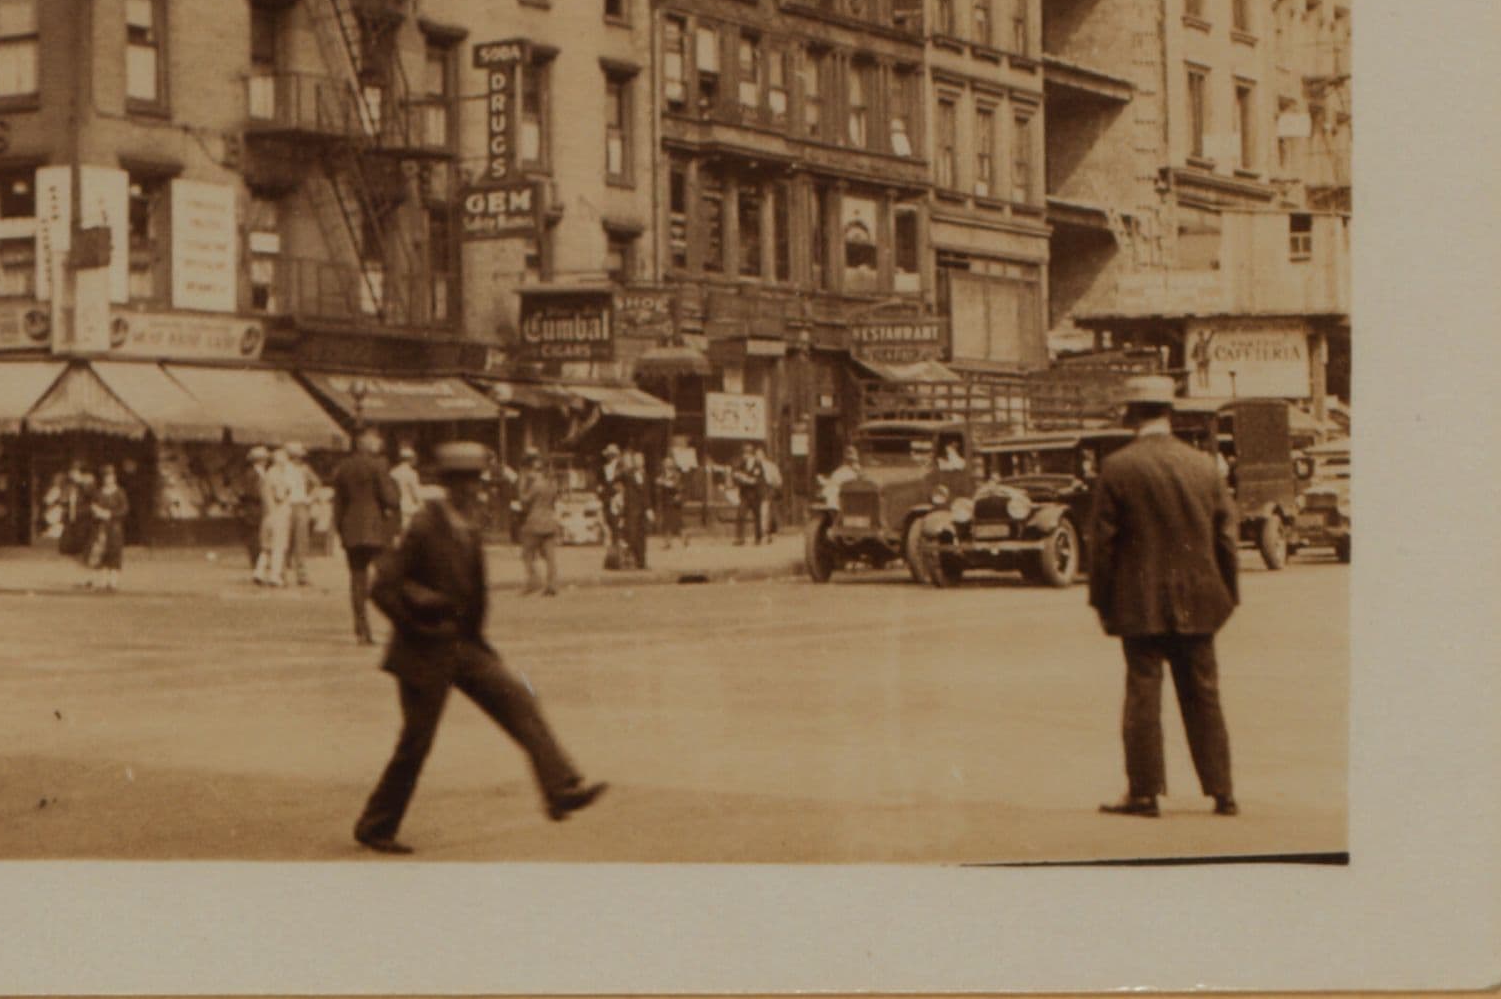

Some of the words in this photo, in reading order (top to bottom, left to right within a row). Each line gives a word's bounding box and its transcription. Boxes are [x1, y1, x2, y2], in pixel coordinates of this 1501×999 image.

[479, 45, 521, 62] SODA
[490, 72, 507, 178] DRUGS
[464, 188, 532, 213] GEM
[1213, 344, 1301, 362] CAFETERIA
